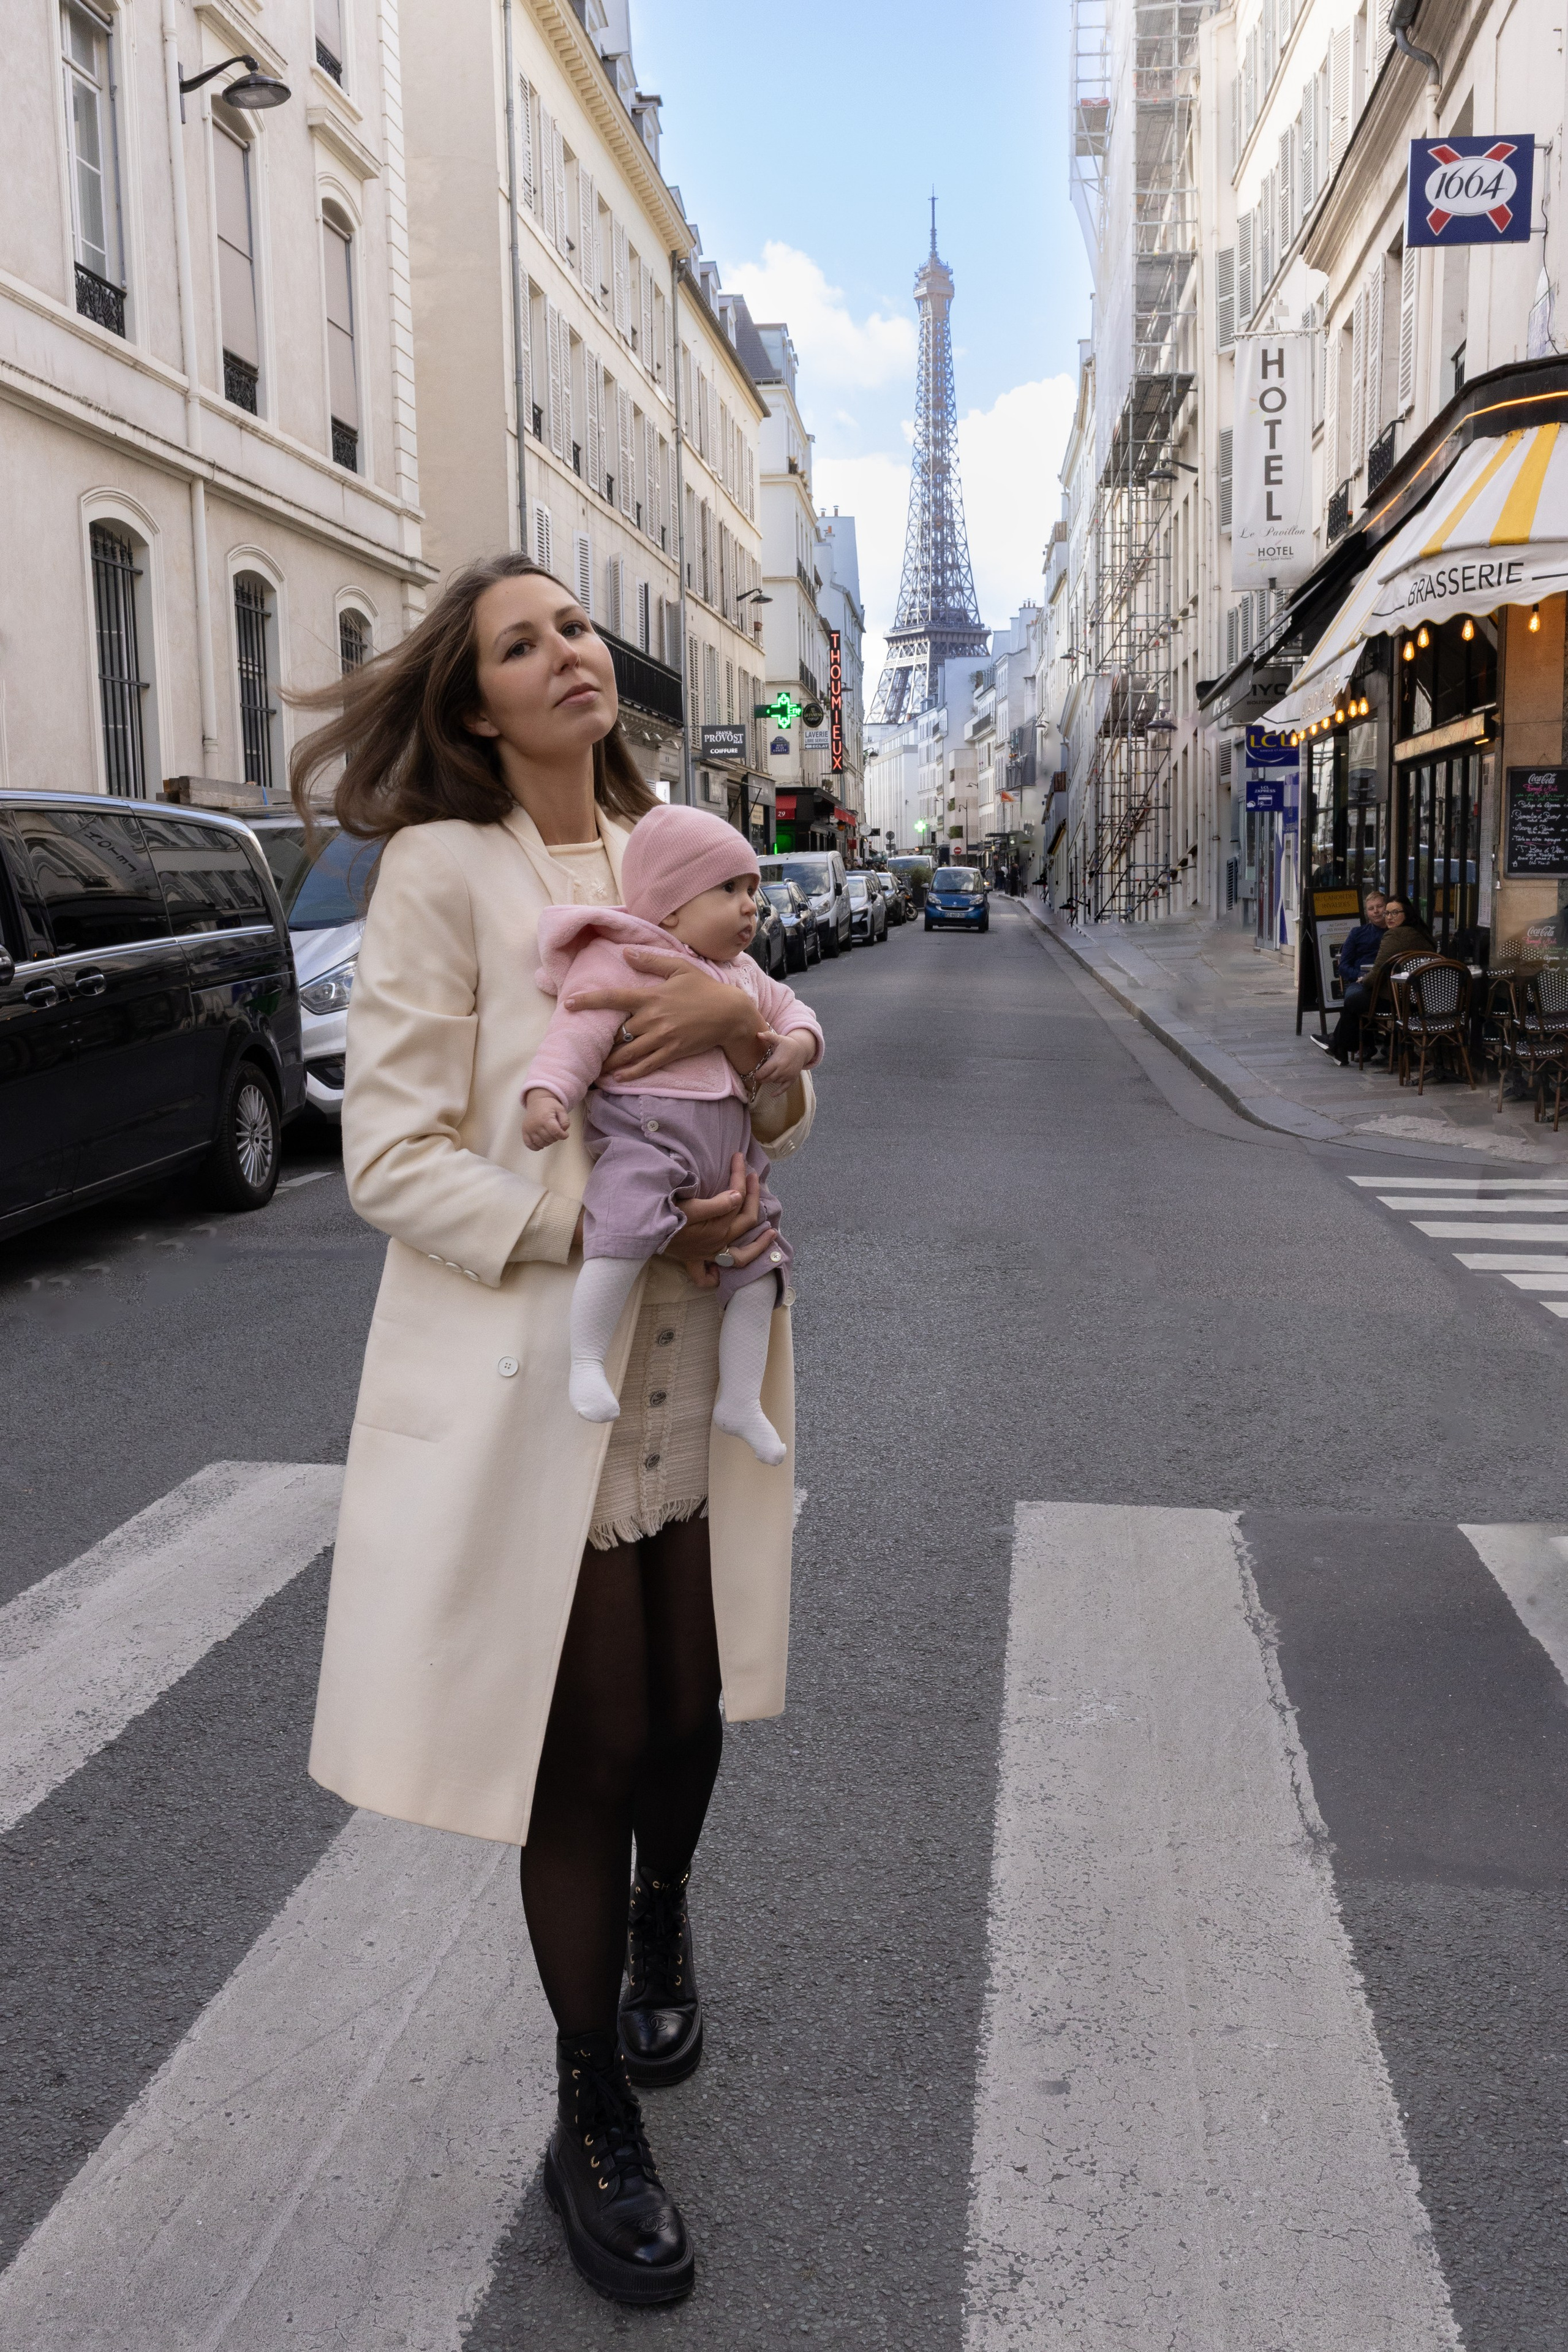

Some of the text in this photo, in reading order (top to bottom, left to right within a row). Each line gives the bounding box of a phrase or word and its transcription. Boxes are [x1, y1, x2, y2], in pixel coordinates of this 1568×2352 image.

[1434, 165, 1506, 200] 1664
[1259, 348, 1287, 521] HOTEL
[1237, 525, 1305, 538] Le Pavillon
[1258, 546, 1294, 557] HOTEL
[1408, 562, 1524, 606] BRASSERIE
[830, 633, 842, 770] THOUMIEUX
[704, 734, 744, 742] PROVOST
[1250, 734, 1294, 747] LCL
